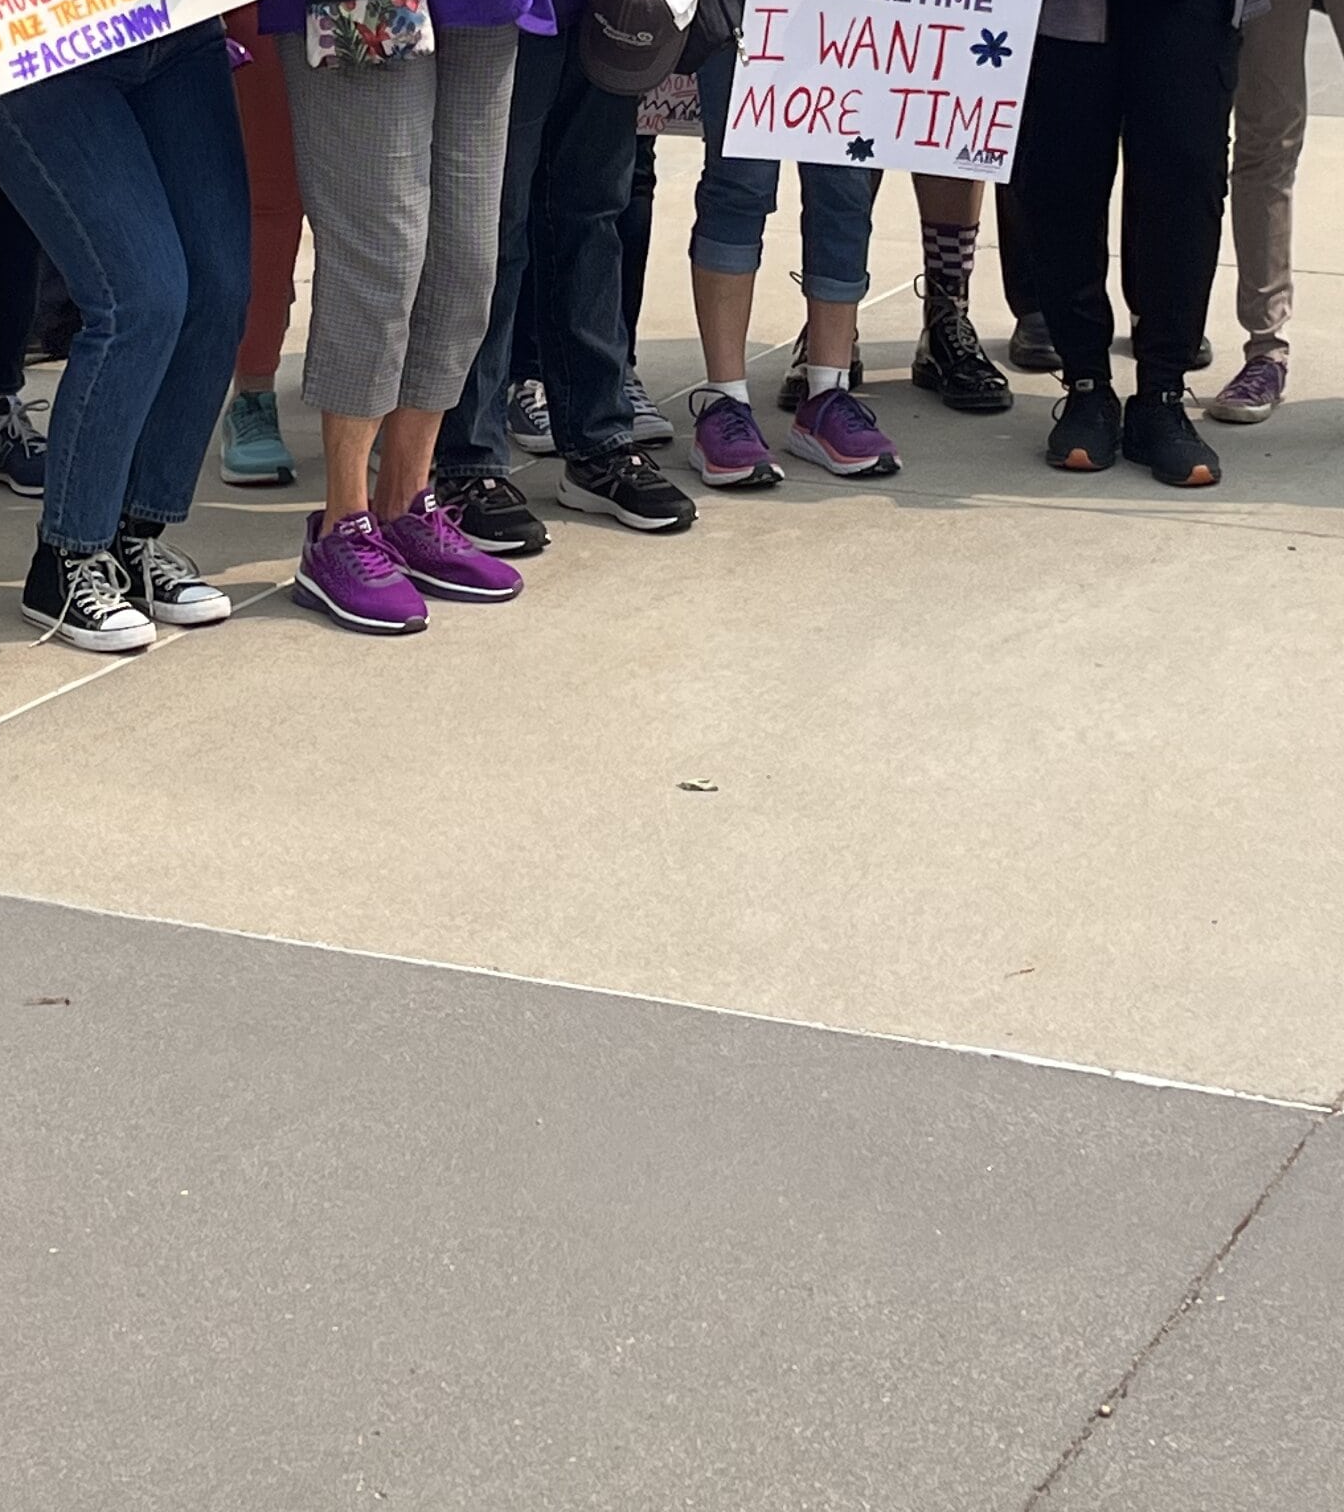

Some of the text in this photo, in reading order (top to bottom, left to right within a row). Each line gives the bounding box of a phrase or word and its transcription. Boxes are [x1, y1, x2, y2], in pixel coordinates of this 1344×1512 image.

[747, 8, 966, 82] I WANT
[732, 84, 1018, 156] MORE TIME
